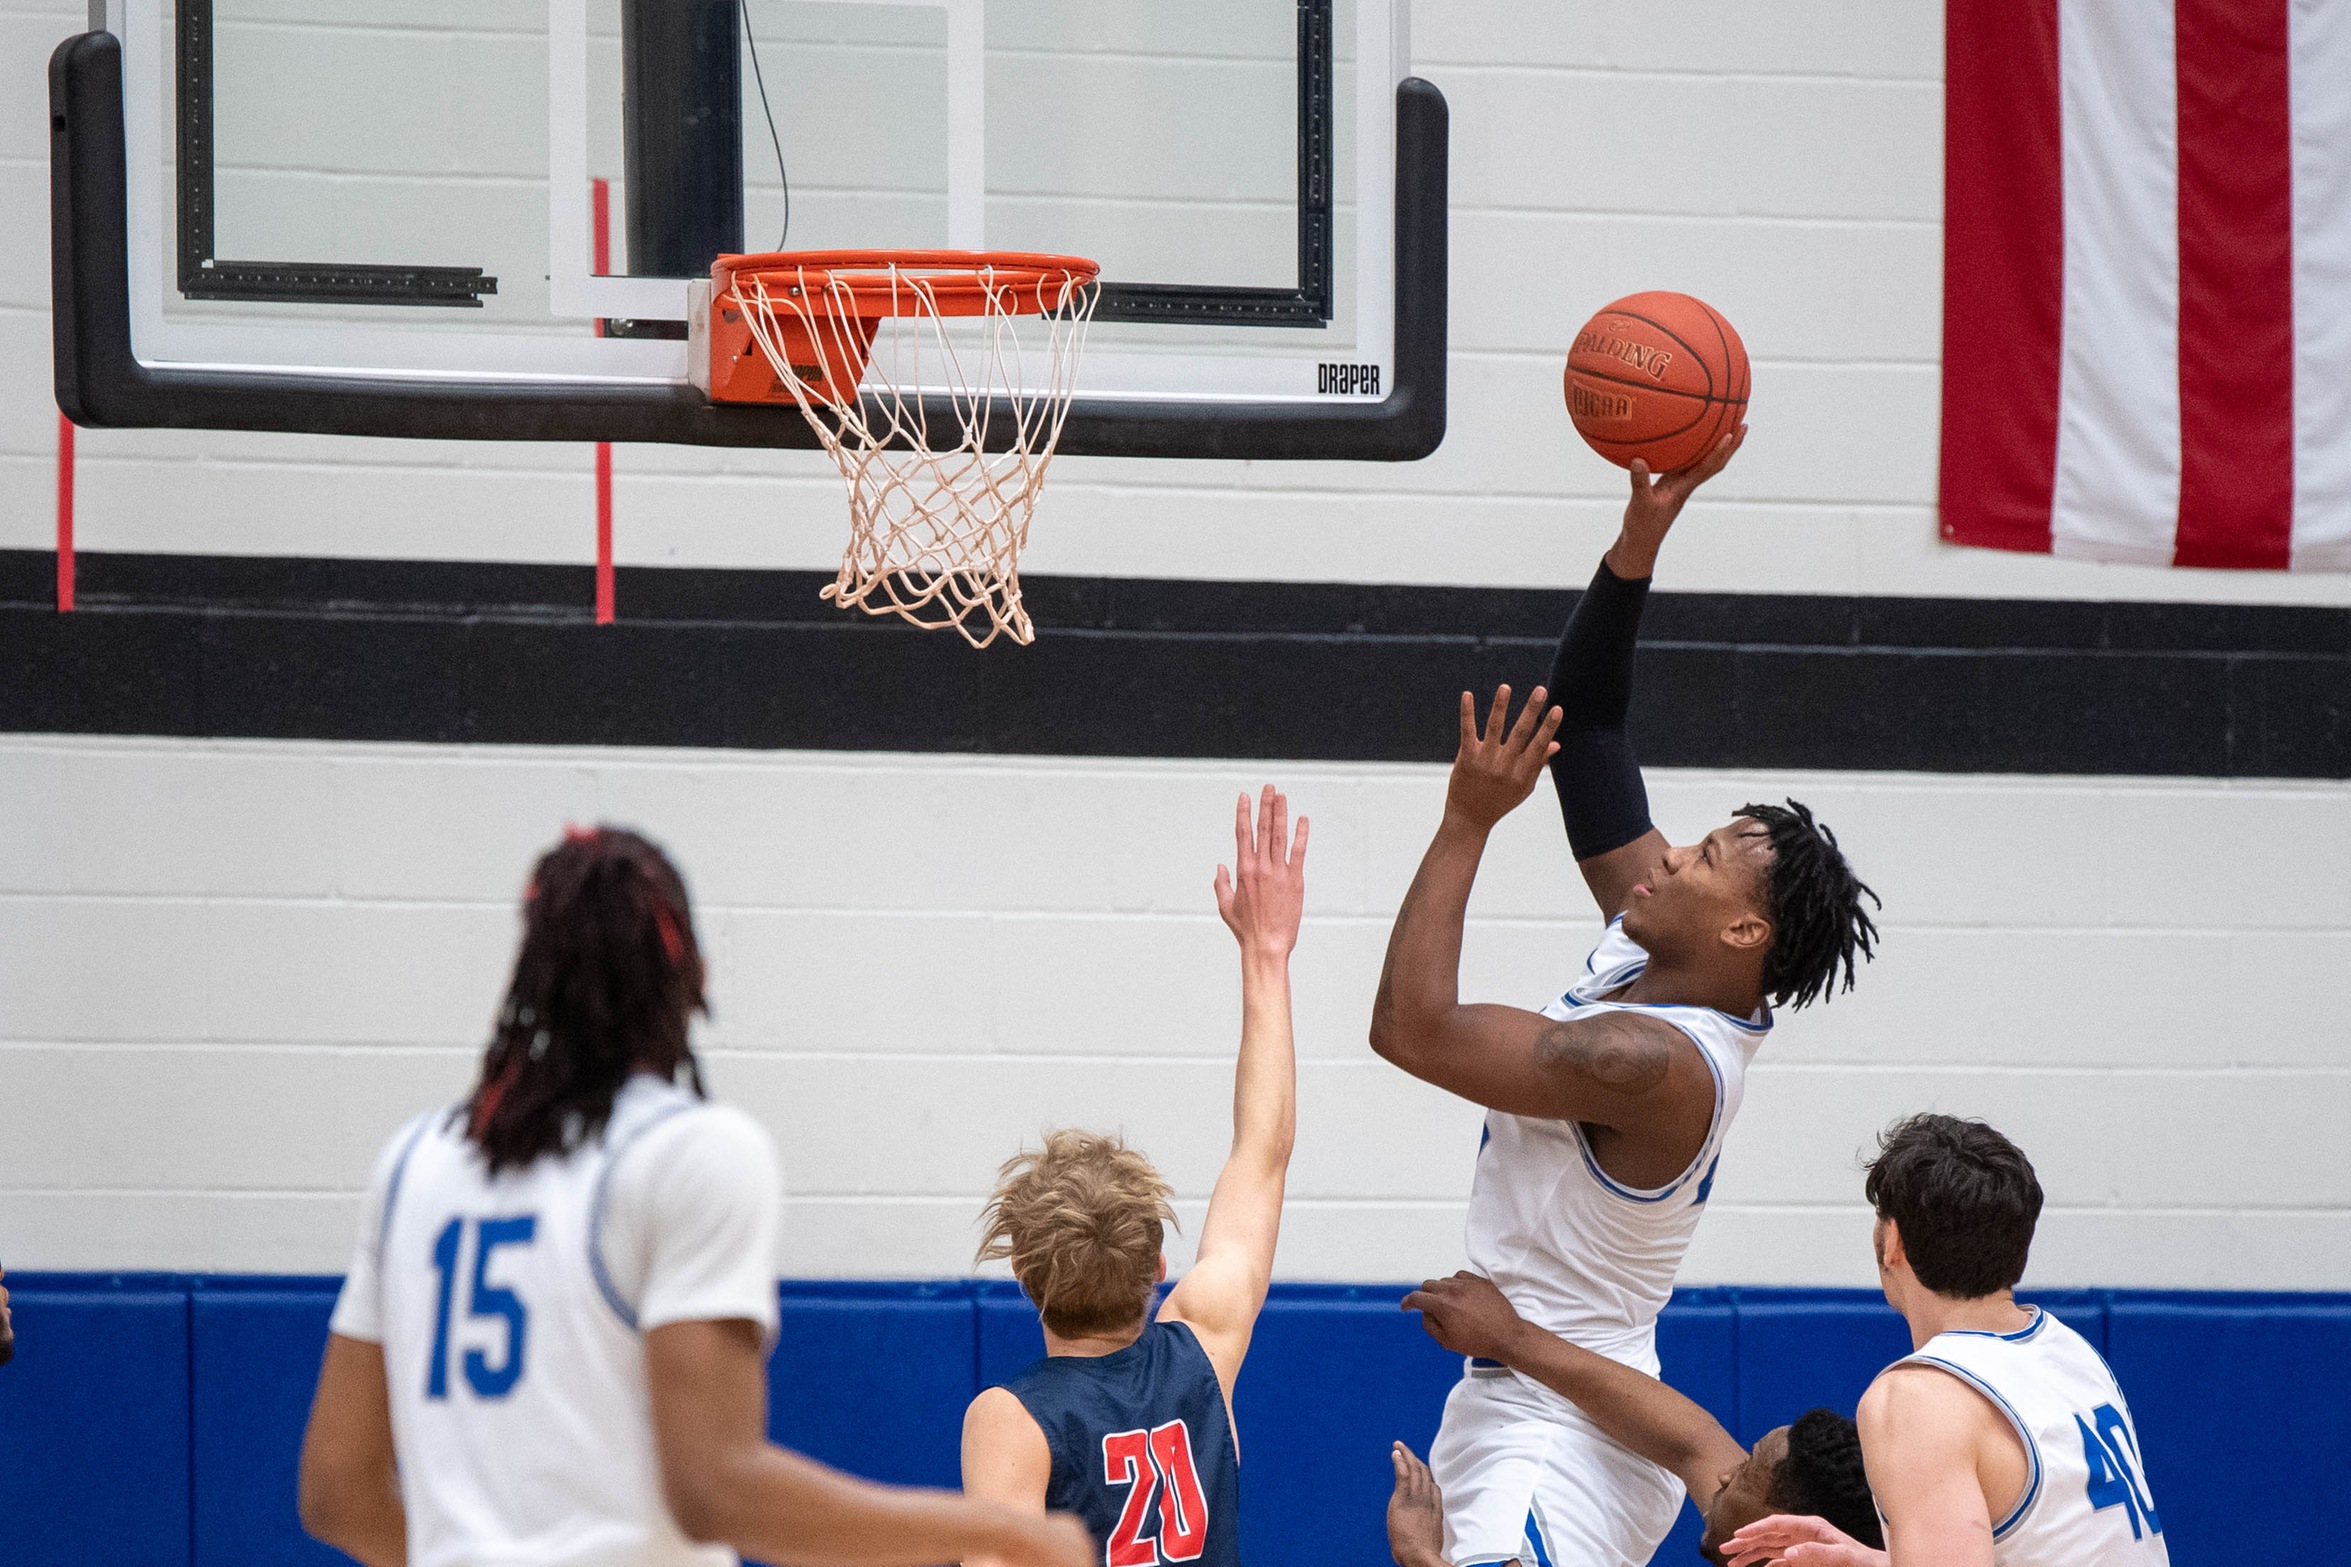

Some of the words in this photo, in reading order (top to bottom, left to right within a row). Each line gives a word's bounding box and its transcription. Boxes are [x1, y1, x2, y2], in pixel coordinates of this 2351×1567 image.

[1573, 330, 1672, 381] PALDING
[426, 1215, 537, 1399] 15
[1102, 1418, 1208, 1567] 20
[2072, 1401, 2163, 1543] 40
